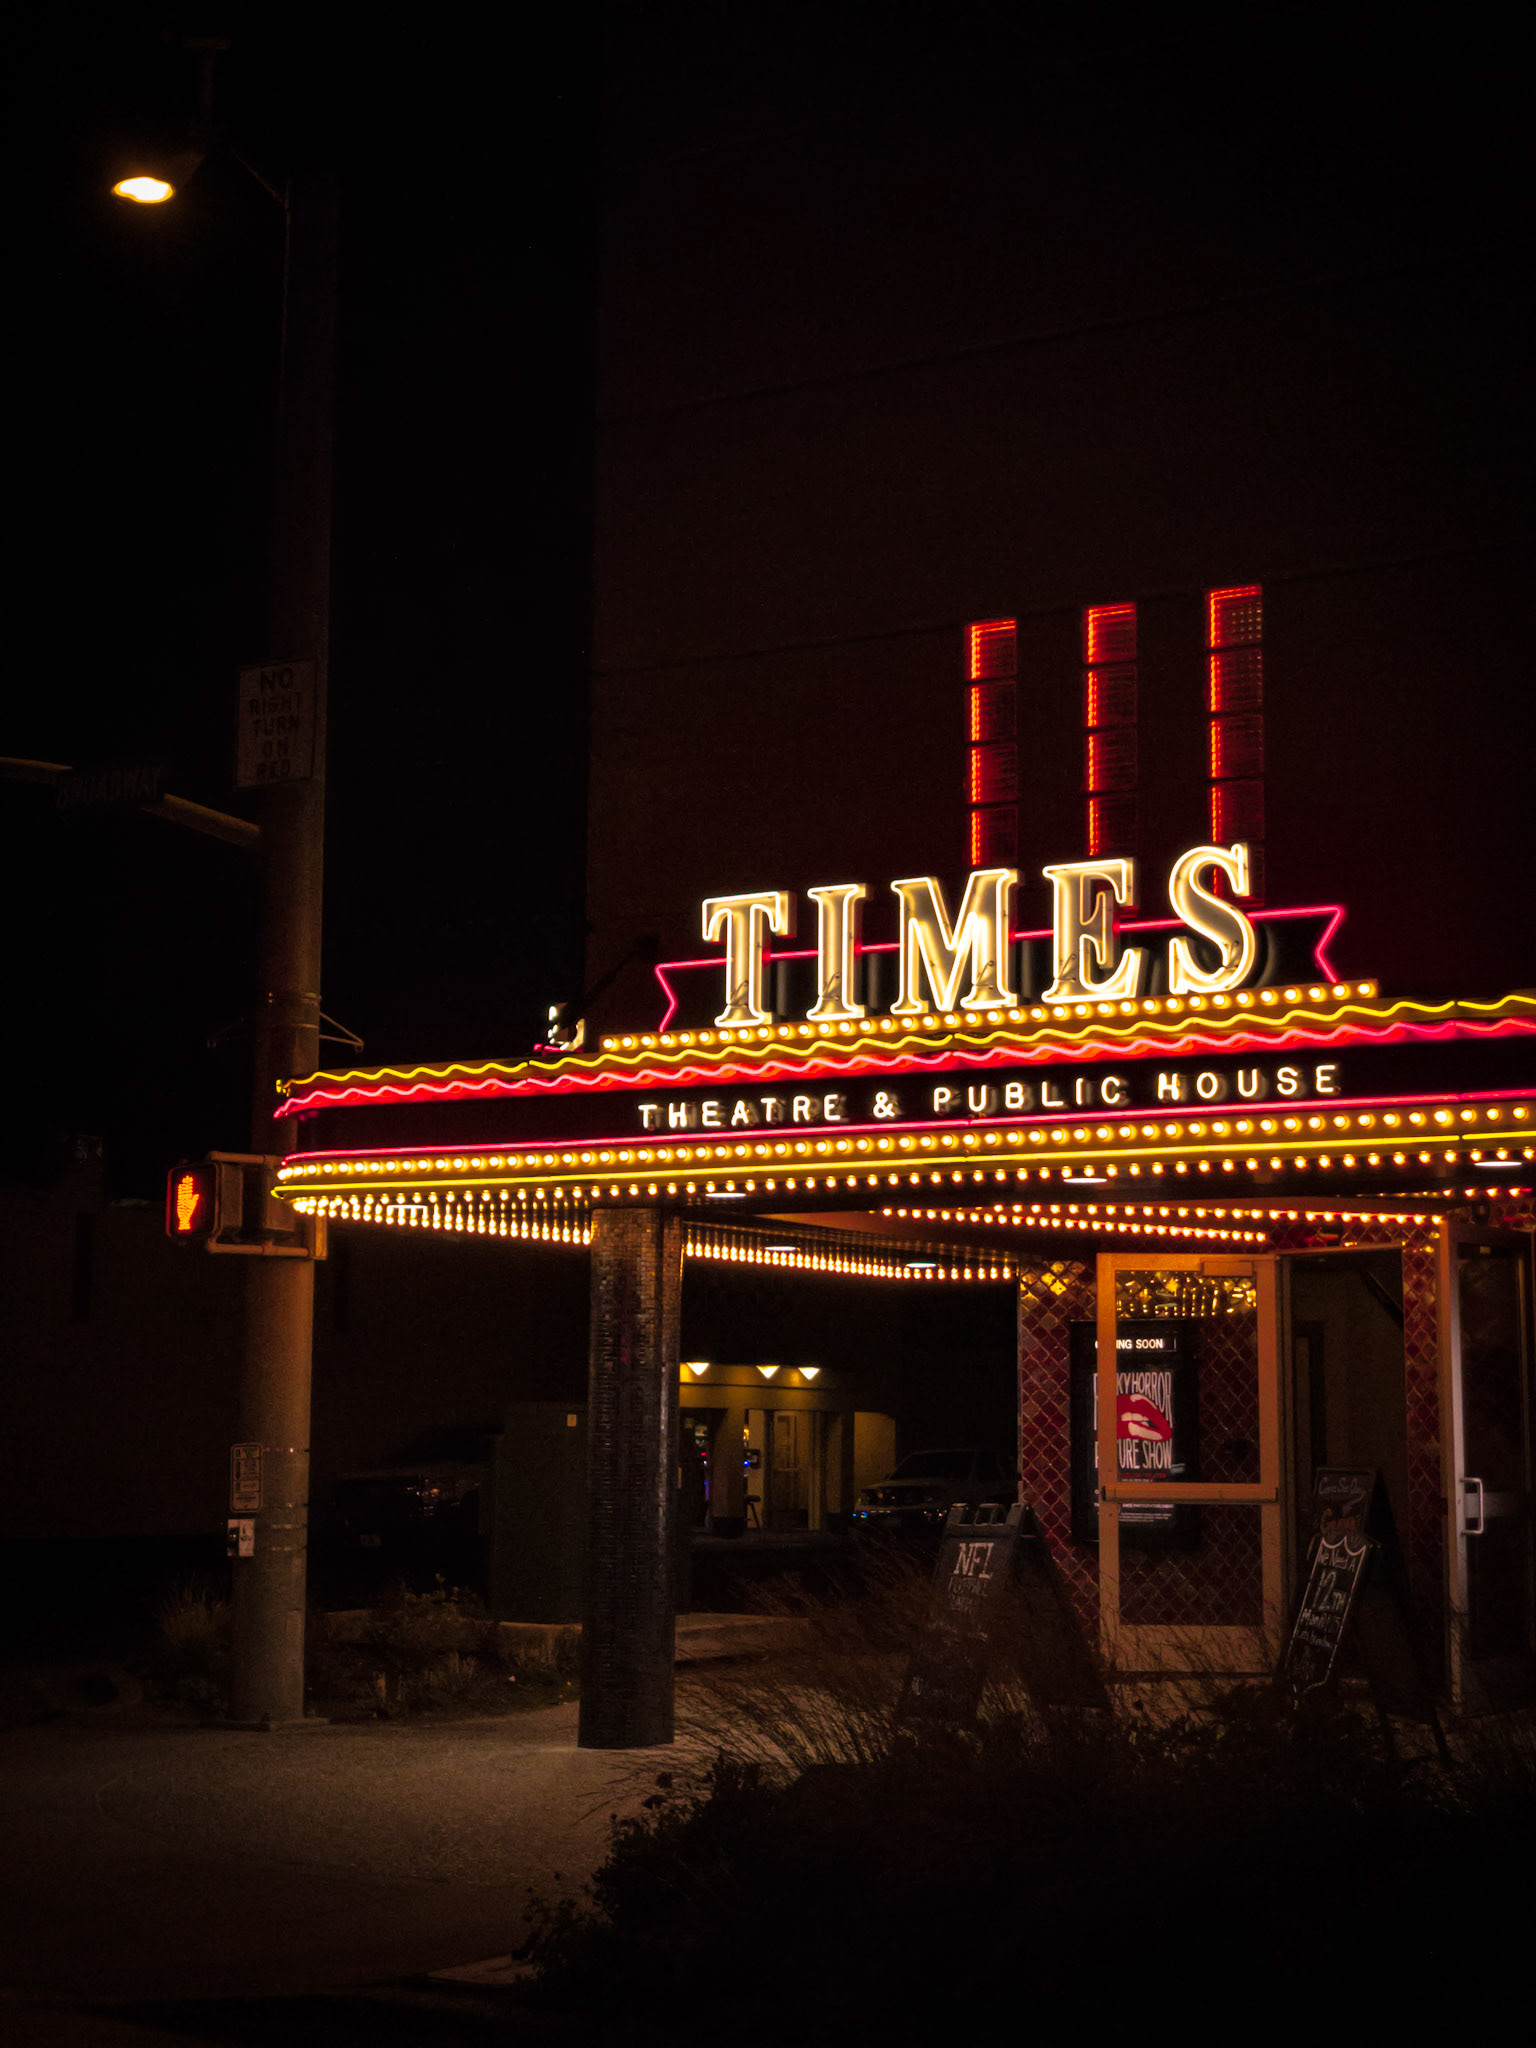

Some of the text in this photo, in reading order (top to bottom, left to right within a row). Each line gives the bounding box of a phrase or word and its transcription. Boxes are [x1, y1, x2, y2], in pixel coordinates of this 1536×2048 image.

[261, 667, 294, 691] NO
[249, 692, 301, 715] RIGHT
[253, 715, 299, 738] TURN
[262, 738, 289, 758] ON
[257, 759, 291, 780] RED
[702, 842, 1258, 1027] TIMES
[637, 1063, 1341, 1129] THEATRE & PUBLIC HOUSE
[1094, 1338, 1164, 1350] ING SOON
[1131, 1371, 1174, 1429] HORROR
[1141, 1438, 1173, 1470] SHOW
[953, 1542, 996, 1579] NFL
